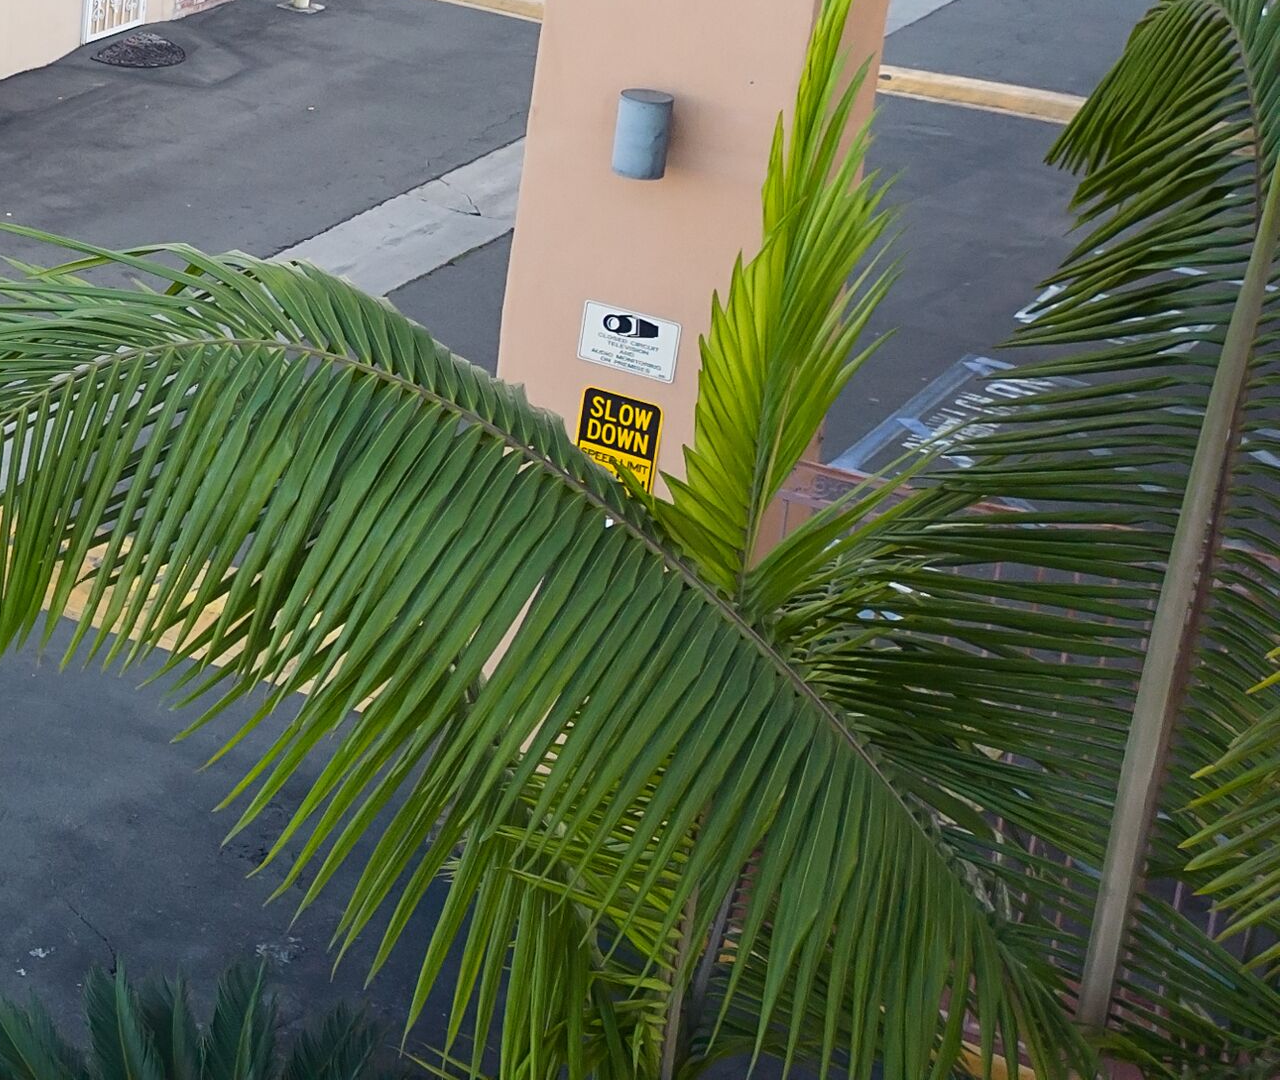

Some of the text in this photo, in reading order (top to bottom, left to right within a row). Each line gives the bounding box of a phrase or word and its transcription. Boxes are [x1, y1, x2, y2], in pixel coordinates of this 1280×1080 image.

[598, 332, 659, 352] CLOSED CIRCUIT
[607, 340, 649, 355] TELEVISION
[590, 395, 653, 431] SLOW
[586, 418, 649, 455] DOWN
